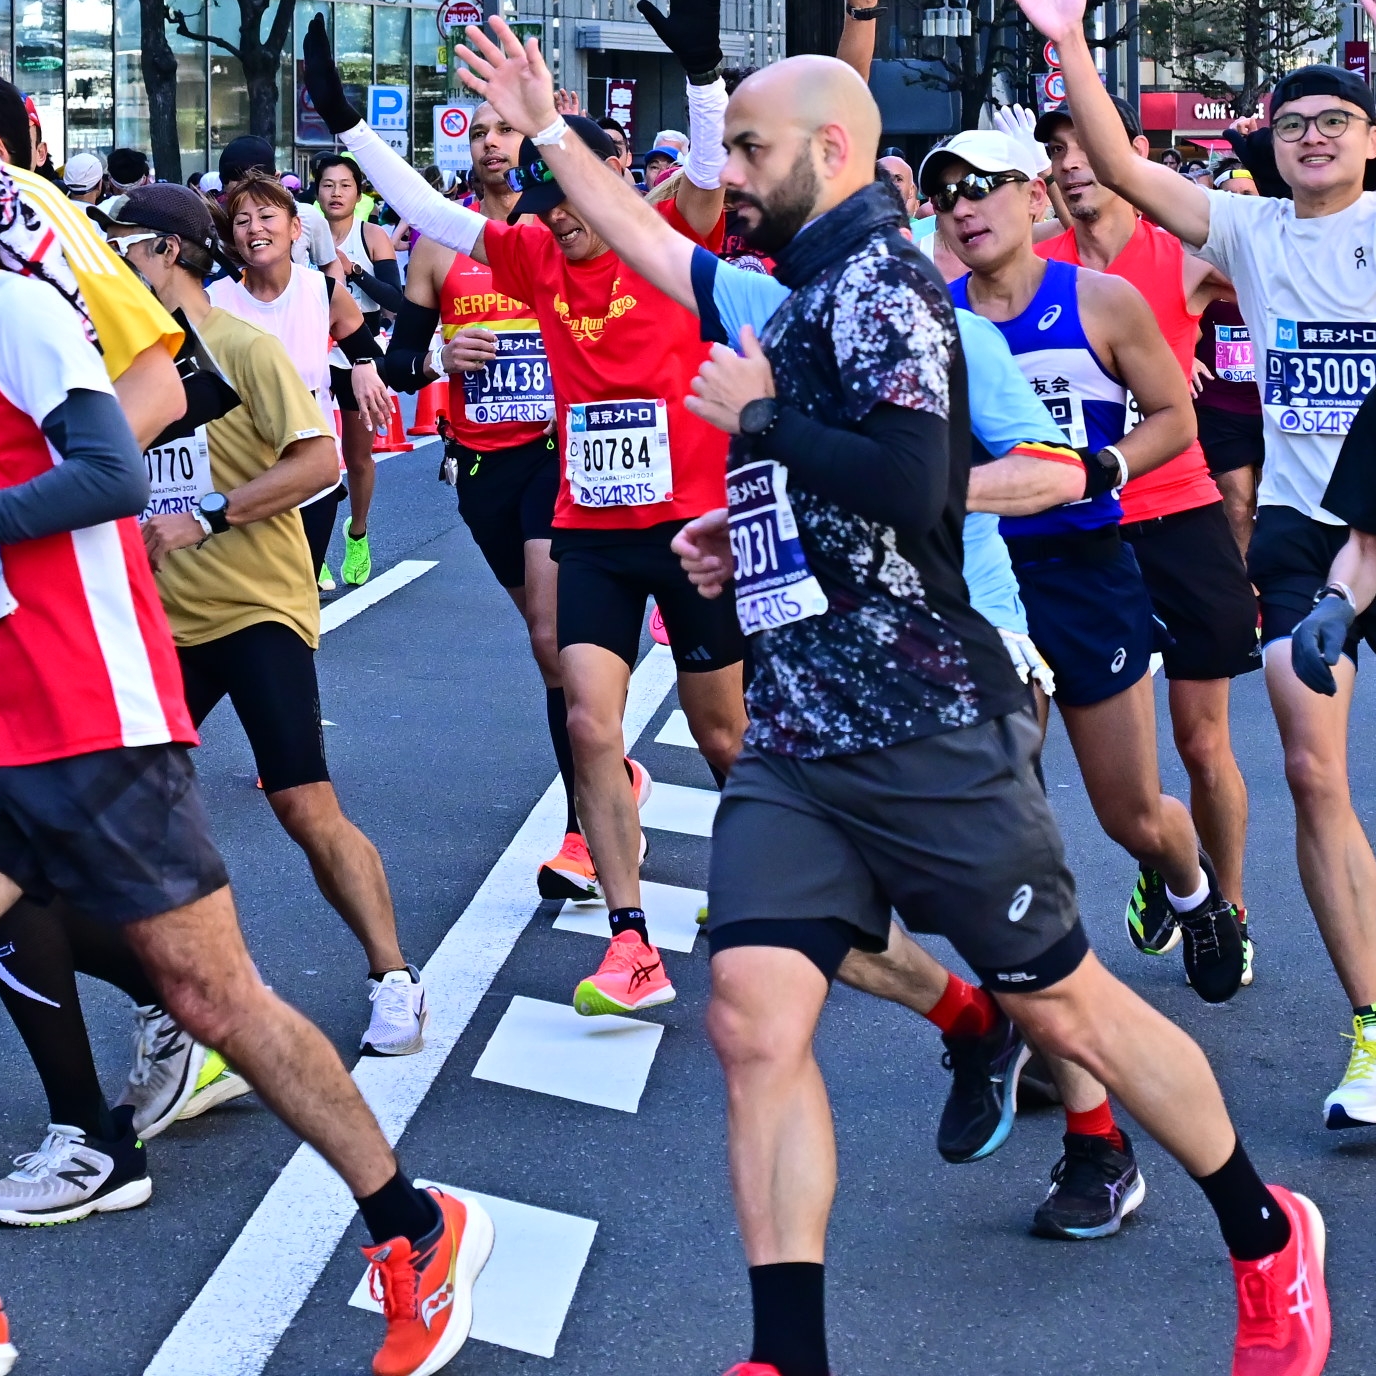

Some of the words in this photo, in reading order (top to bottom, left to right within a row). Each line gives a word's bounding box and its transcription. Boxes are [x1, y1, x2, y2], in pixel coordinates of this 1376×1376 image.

[372, 89, 403, 126] P
[1193, 102, 1226, 120] CAFFE
[453, 293, 531, 316] SERPEN
[1302, 327, 1376, 344] 東京メトロ
[1269, 354, 1282, 376] D
[481, 362, 545, 393] 34438
[1289, 357, 1376, 395] 35009
[1271, 388, 1282, 404] 2
[1310, 399, 1334, 407] TOKYO
[490, 403, 547, 421] STARTS
[589, 408, 651, 425] 東京メトロ
[570, 441, 579, 457] C
[583, 435, 651, 472] 80784
[592, 483, 656, 505] STARTS
